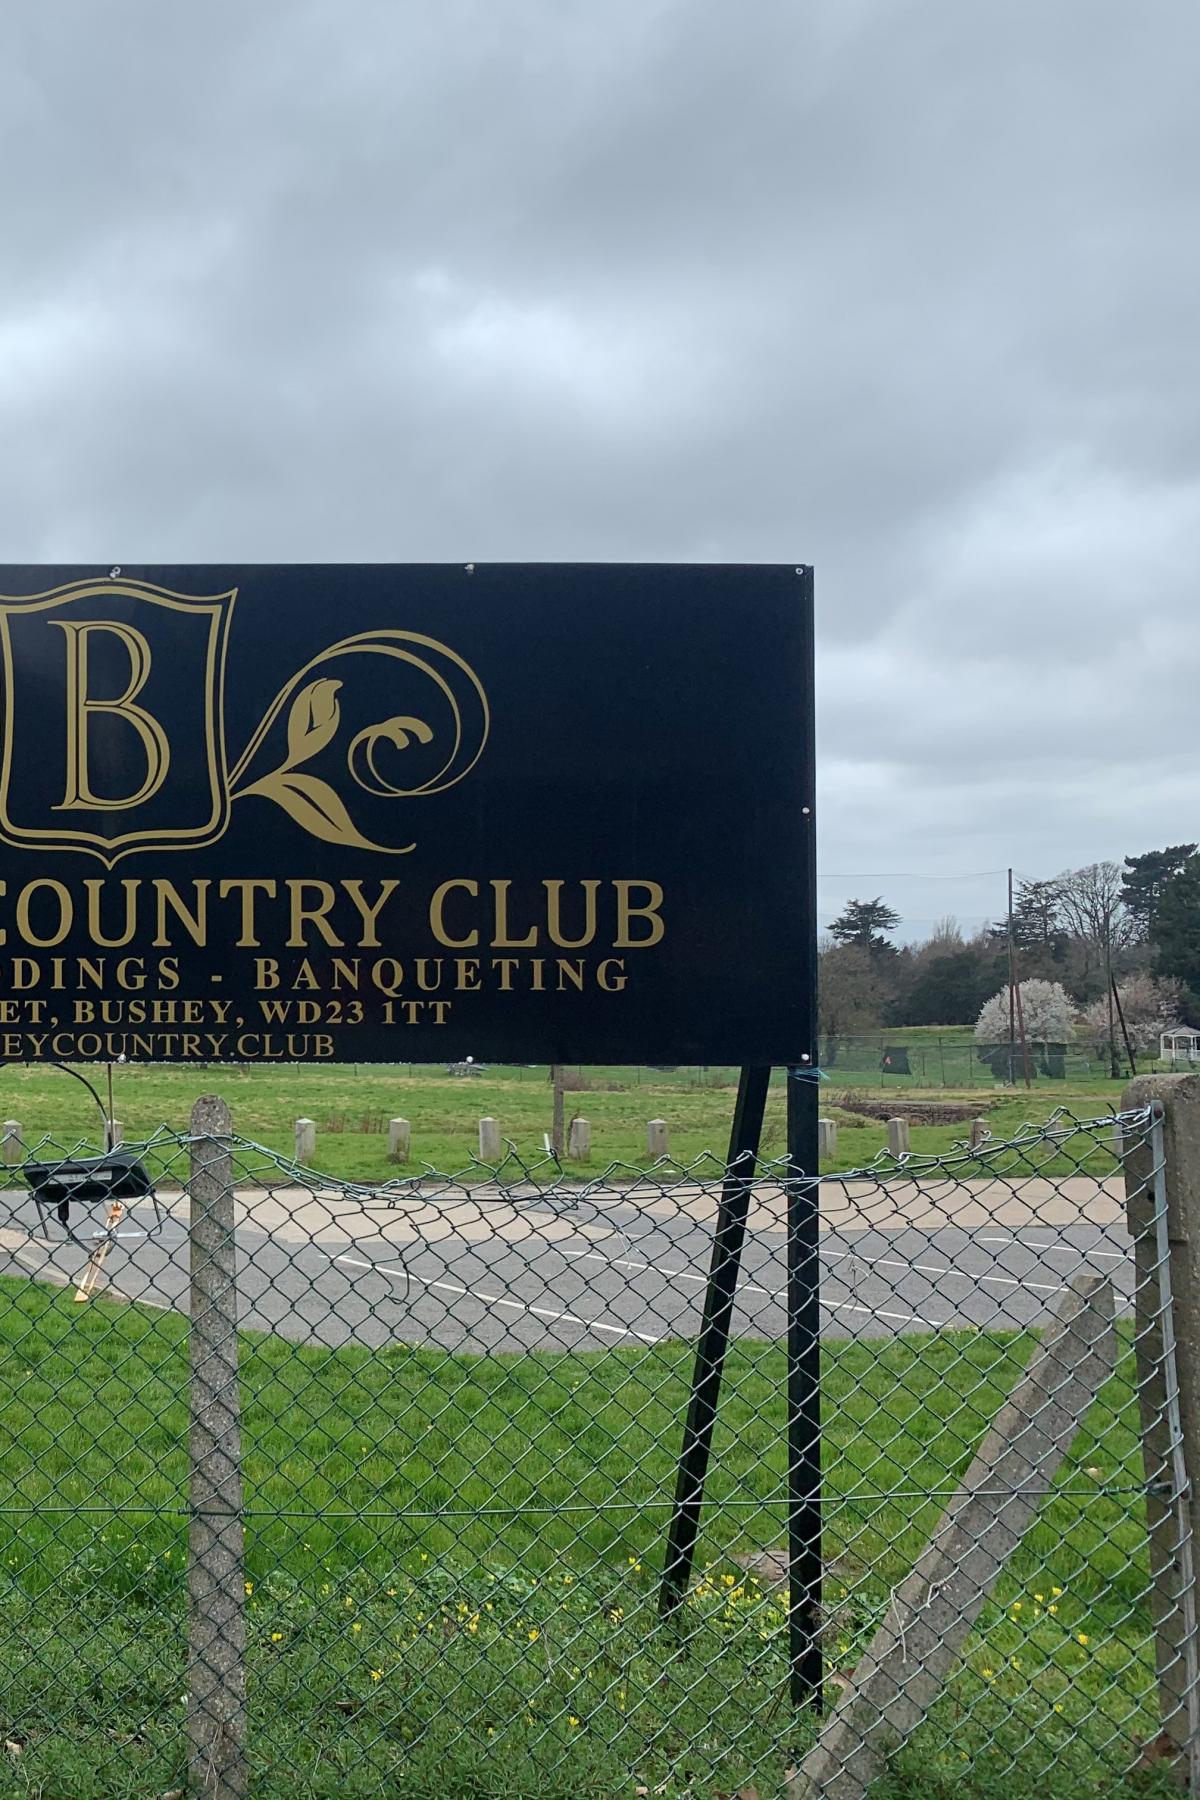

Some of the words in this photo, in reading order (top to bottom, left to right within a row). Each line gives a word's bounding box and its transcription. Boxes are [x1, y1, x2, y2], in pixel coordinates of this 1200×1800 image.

[47, 620, 171, 811] B
[430, 879, 666, 948] CLUB
[253, 957, 631, 997] BANQUETING
[73, 1000, 244, 1029] BUSHEY,
[258, 1000, 365, 1025] WD23
[381, 1001, 452, 1025] 1TT
